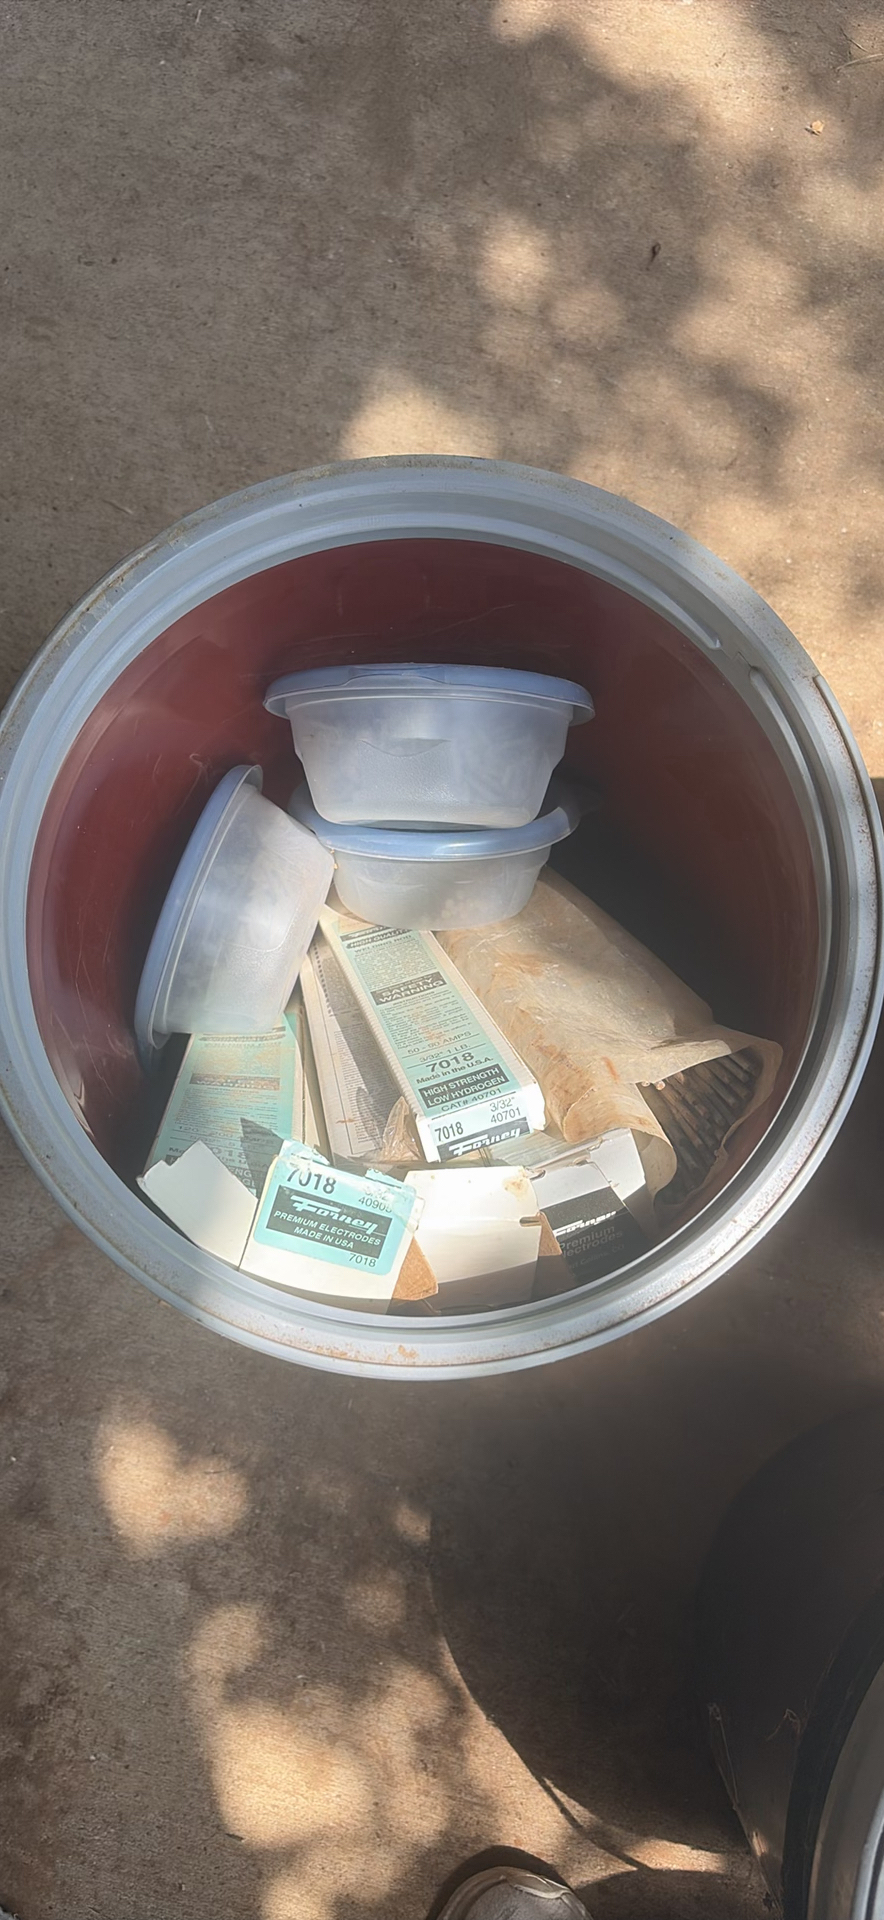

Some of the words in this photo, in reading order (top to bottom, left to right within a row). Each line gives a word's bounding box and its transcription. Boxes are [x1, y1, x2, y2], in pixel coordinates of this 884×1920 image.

[379, 980, 444, 1003] WARNING
[382, 977, 433, 996] SAFETY
[443, 1031, 472, 1045] AMPS
[454, 1043, 471, 1053] LB.
[416, 1071, 441, 1084] Made
[442, 1067, 452, 1077] in
[452, 1063, 467, 1075] the
[467, 1056, 494, 1069] U.S.A.
[425, 1052, 475, 1073] 7018
[423, 1084, 448, 1098] HIGH
[450, 1067, 500, 1089] STRENGTH
[427, 1093, 451, 1106] LOW
[451, 1075, 506, 1098] HYDROGEN
[441, 1099, 469, 1112] CAT#
[471, 1088, 502, 1104] 40701
[490, 1107, 521, 1124] 40701
[434, 1122, 464, 1142] 7018
[449, 1128, 521, 1156] Forney
[286, 1168, 337, 1195] 7018
[290, 1195, 379, 1235] Forney
[273, 1210, 319, 1228] PREMIUM
[319, 1221, 381, 1246] ELECTRODES
[294, 1226, 321, 1240] MADE
[323, 1233, 333, 1243] IN
[335, 1237, 355, 1249] USA
[559, 1226, 615, 1250] Premium
[562, 1232, 623, 1258] lectrodes
[348, 1253, 377, 1268] 7018
